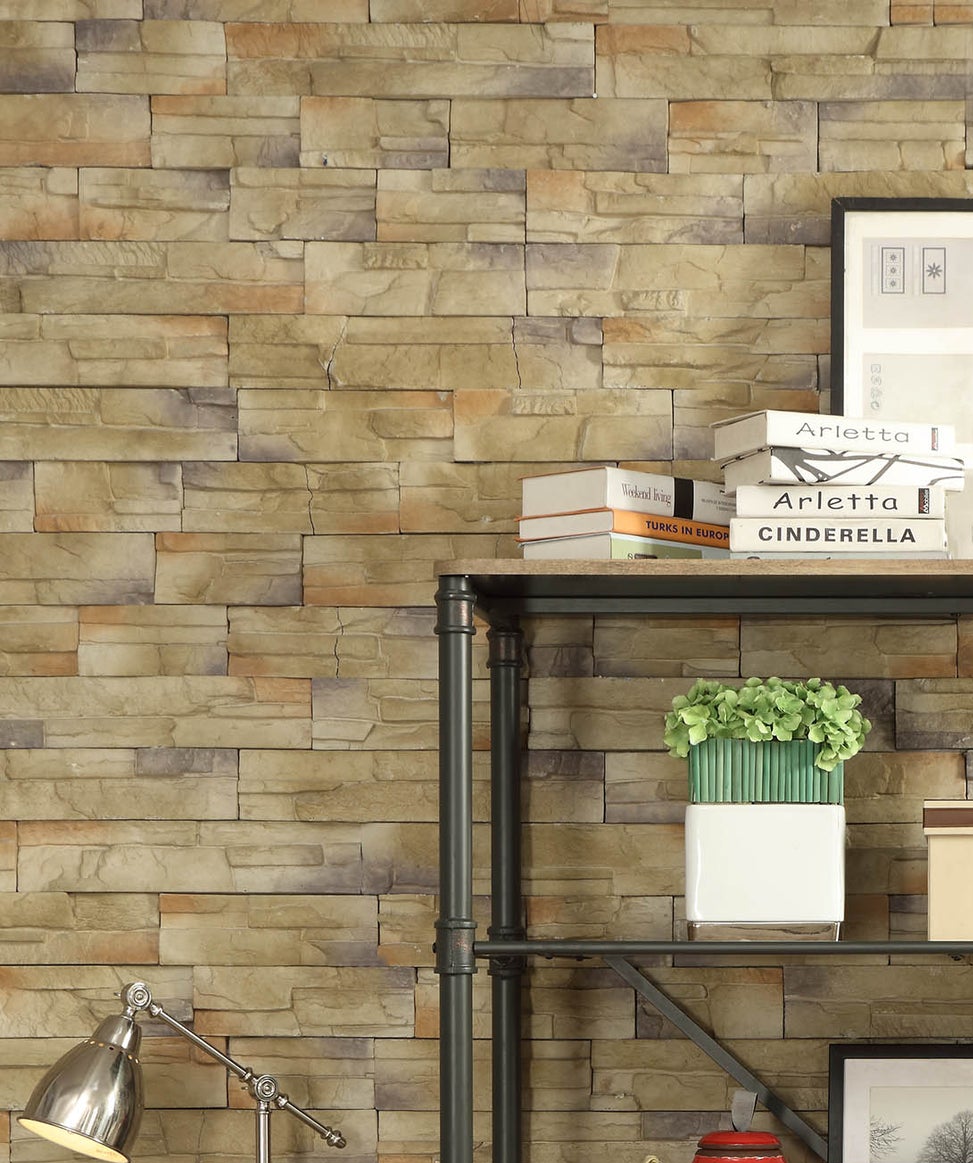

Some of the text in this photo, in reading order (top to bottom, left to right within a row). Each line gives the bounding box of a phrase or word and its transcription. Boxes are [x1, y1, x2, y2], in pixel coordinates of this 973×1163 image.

[795, 422, 910, 443] Arletta
[621, 483, 672, 507] Weekend living
[773, 491, 898, 510] Arletta
[645, 520, 729, 540] TURKS IN EUROP
[758, 526, 916, 543] CINDERELLA
